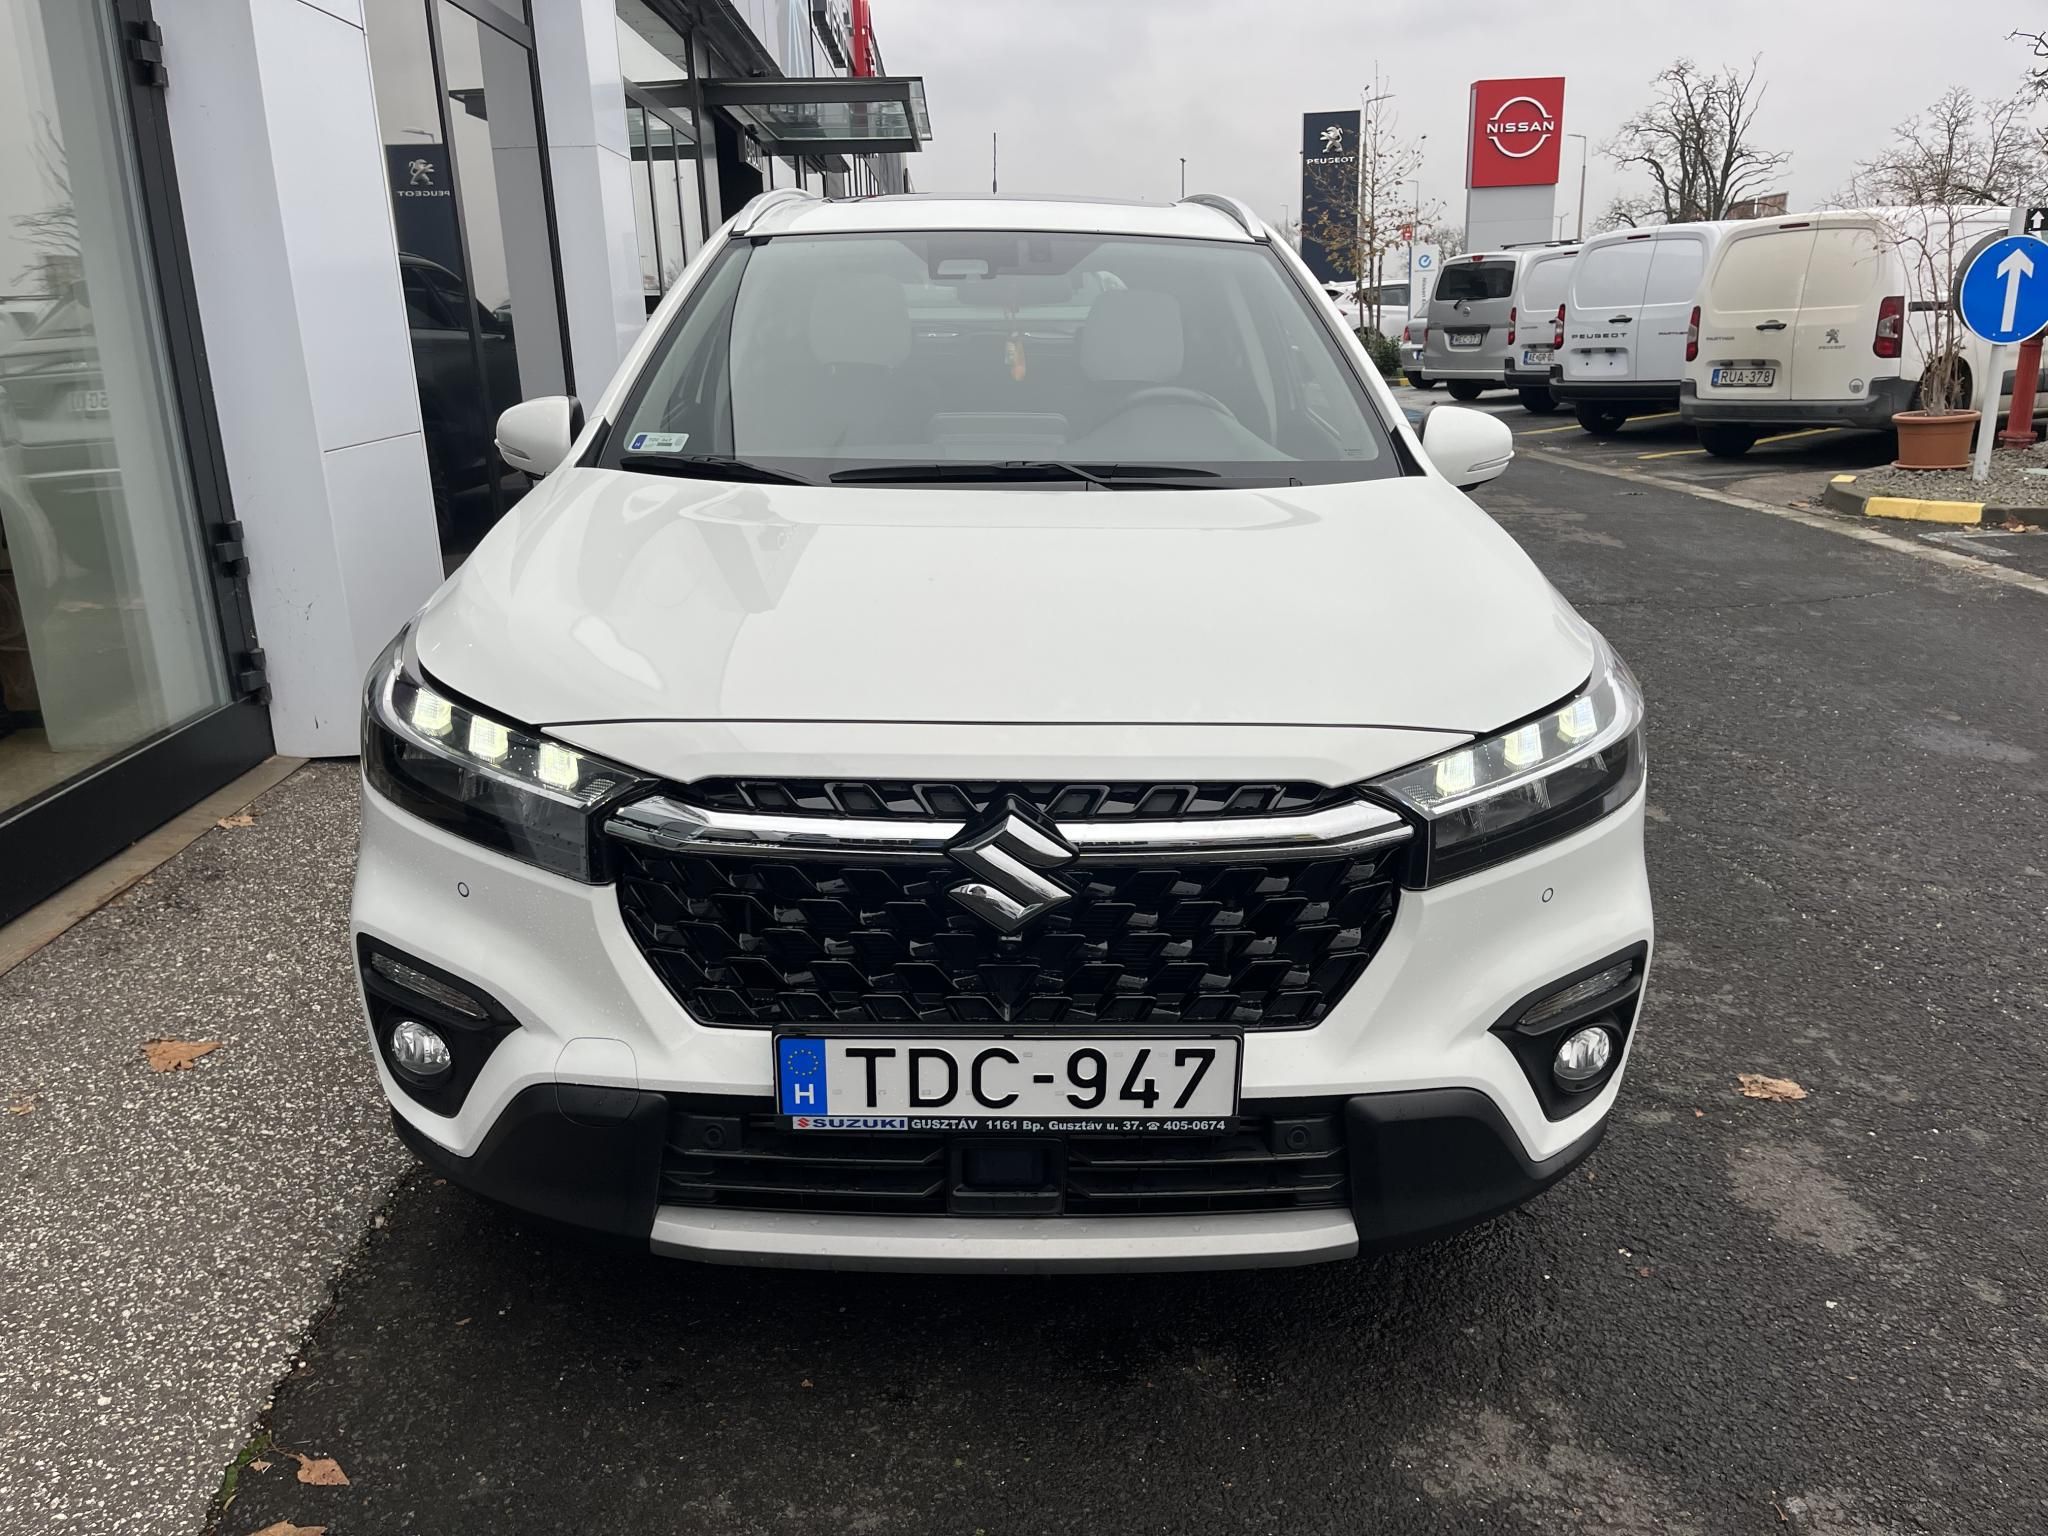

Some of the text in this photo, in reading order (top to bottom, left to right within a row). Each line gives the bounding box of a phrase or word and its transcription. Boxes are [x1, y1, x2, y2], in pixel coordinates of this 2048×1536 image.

[1487, 121, 1554, 133] NISSAN
[1306, 156, 1356, 164] PEUGEOT
[1720, 370, 1771, 383] RUA-378
[845, 1047, 1216, 1109] TDC-947
[795, 1084, 814, 1105] H
[812, 1118, 1226, 1133] SUZUKI GUSZTÁV 1161 Bp. Gusztáv u. 37. 405-0674
